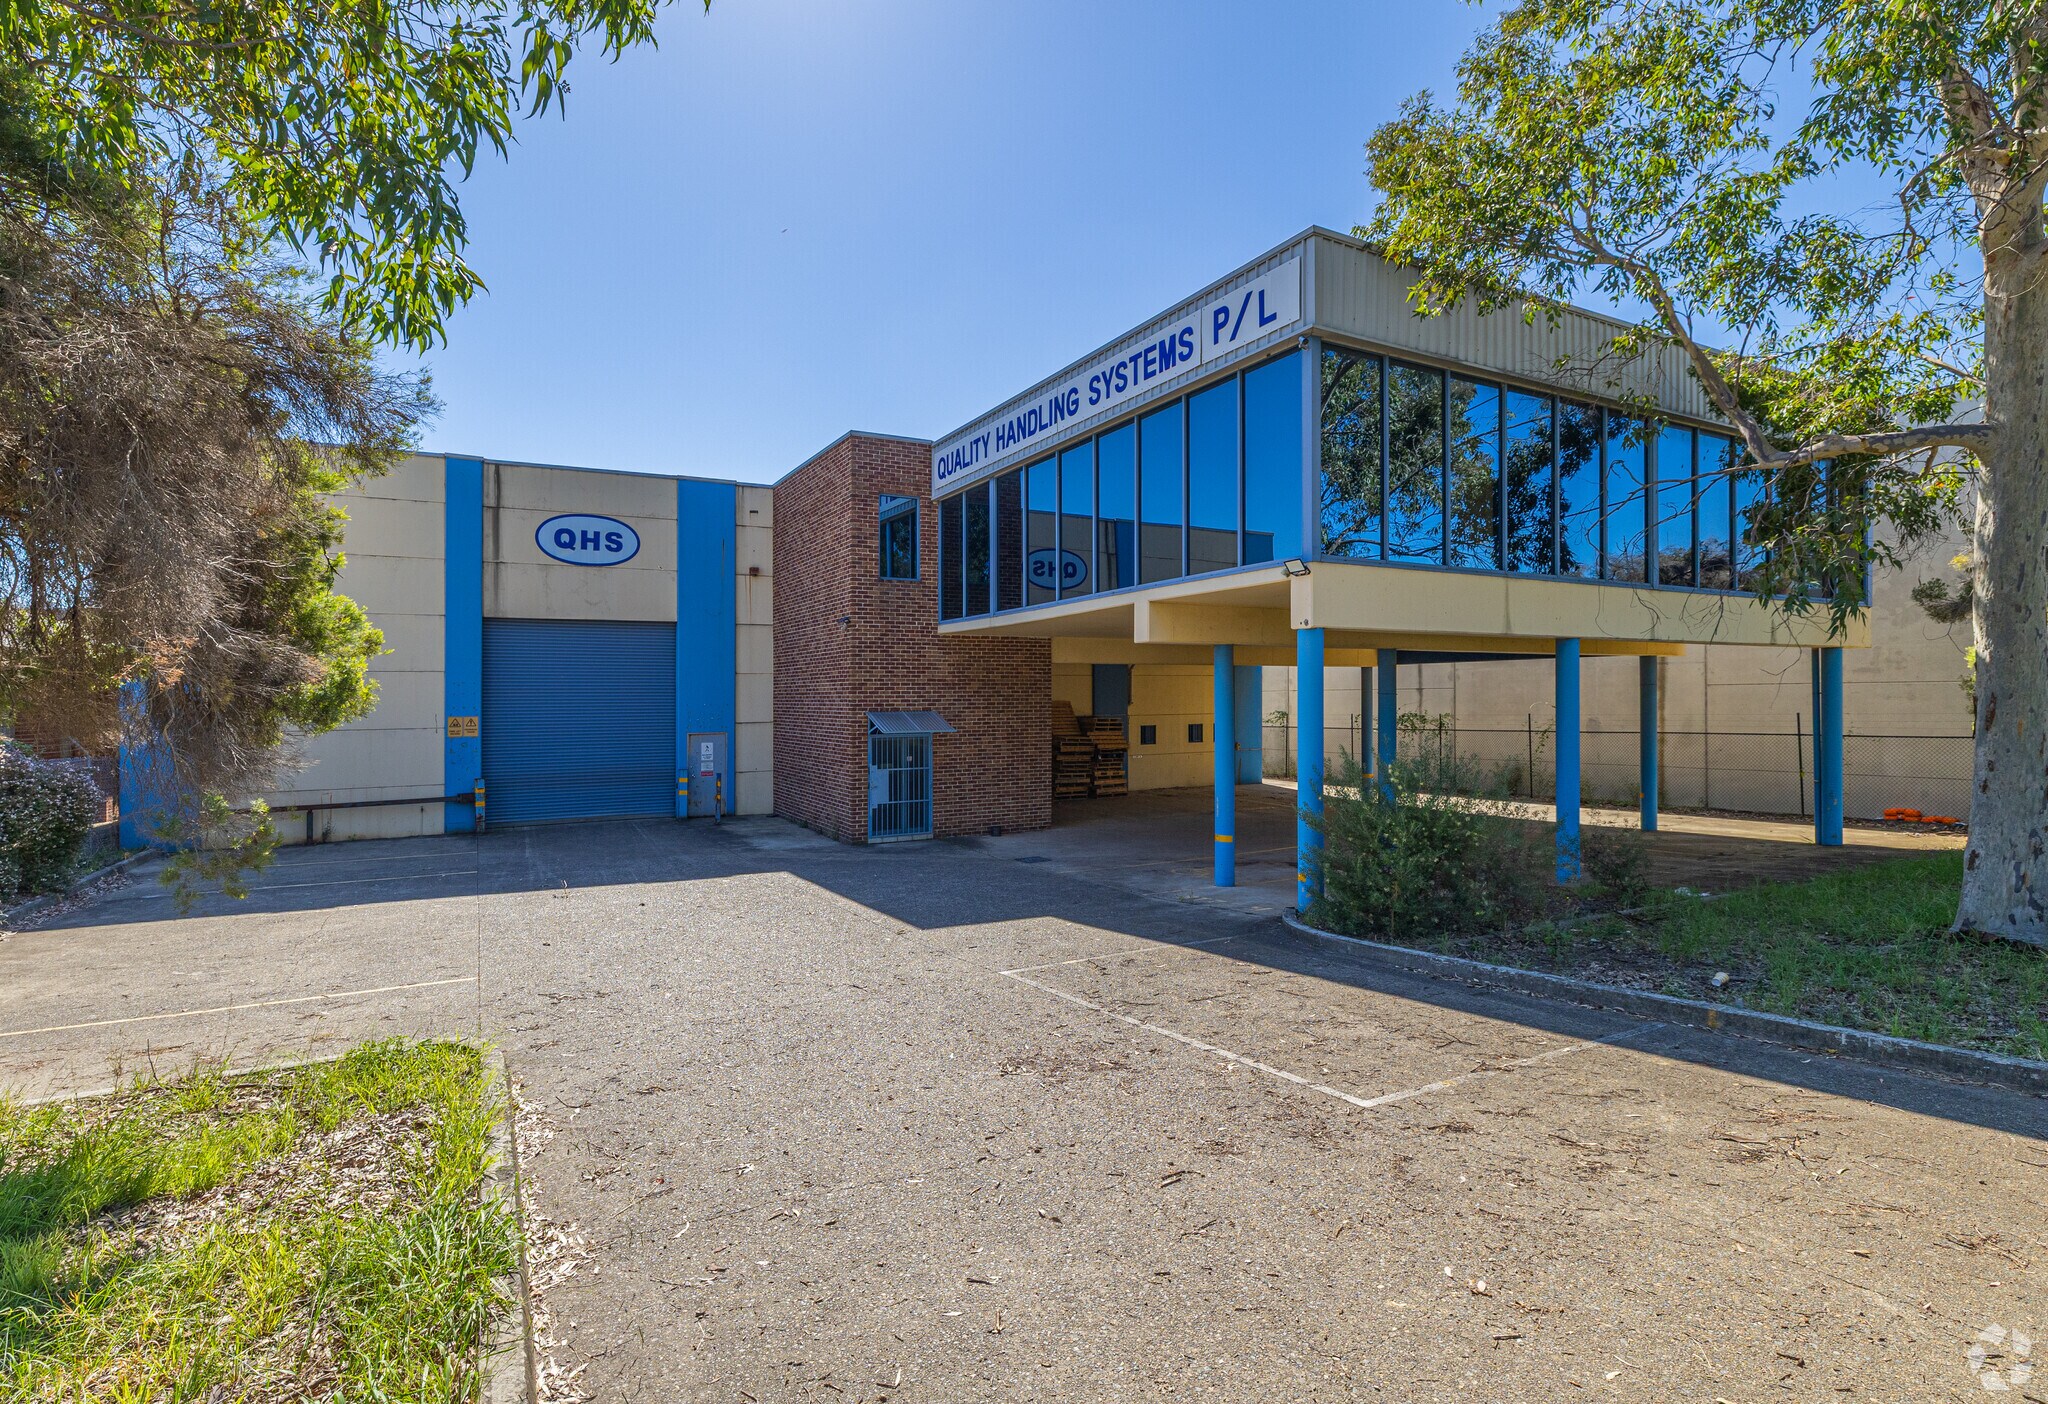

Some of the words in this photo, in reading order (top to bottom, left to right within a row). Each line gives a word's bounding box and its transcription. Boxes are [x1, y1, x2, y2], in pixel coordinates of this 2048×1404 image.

[937, 432, 991, 480] QUALITY
[996, 387, 1080, 453] HANDLING
[1088, 326, 1194, 406] SYSTEMS
[1213, 289, 1277, 345] P/L
[553, 527, 624, 553] QHS
